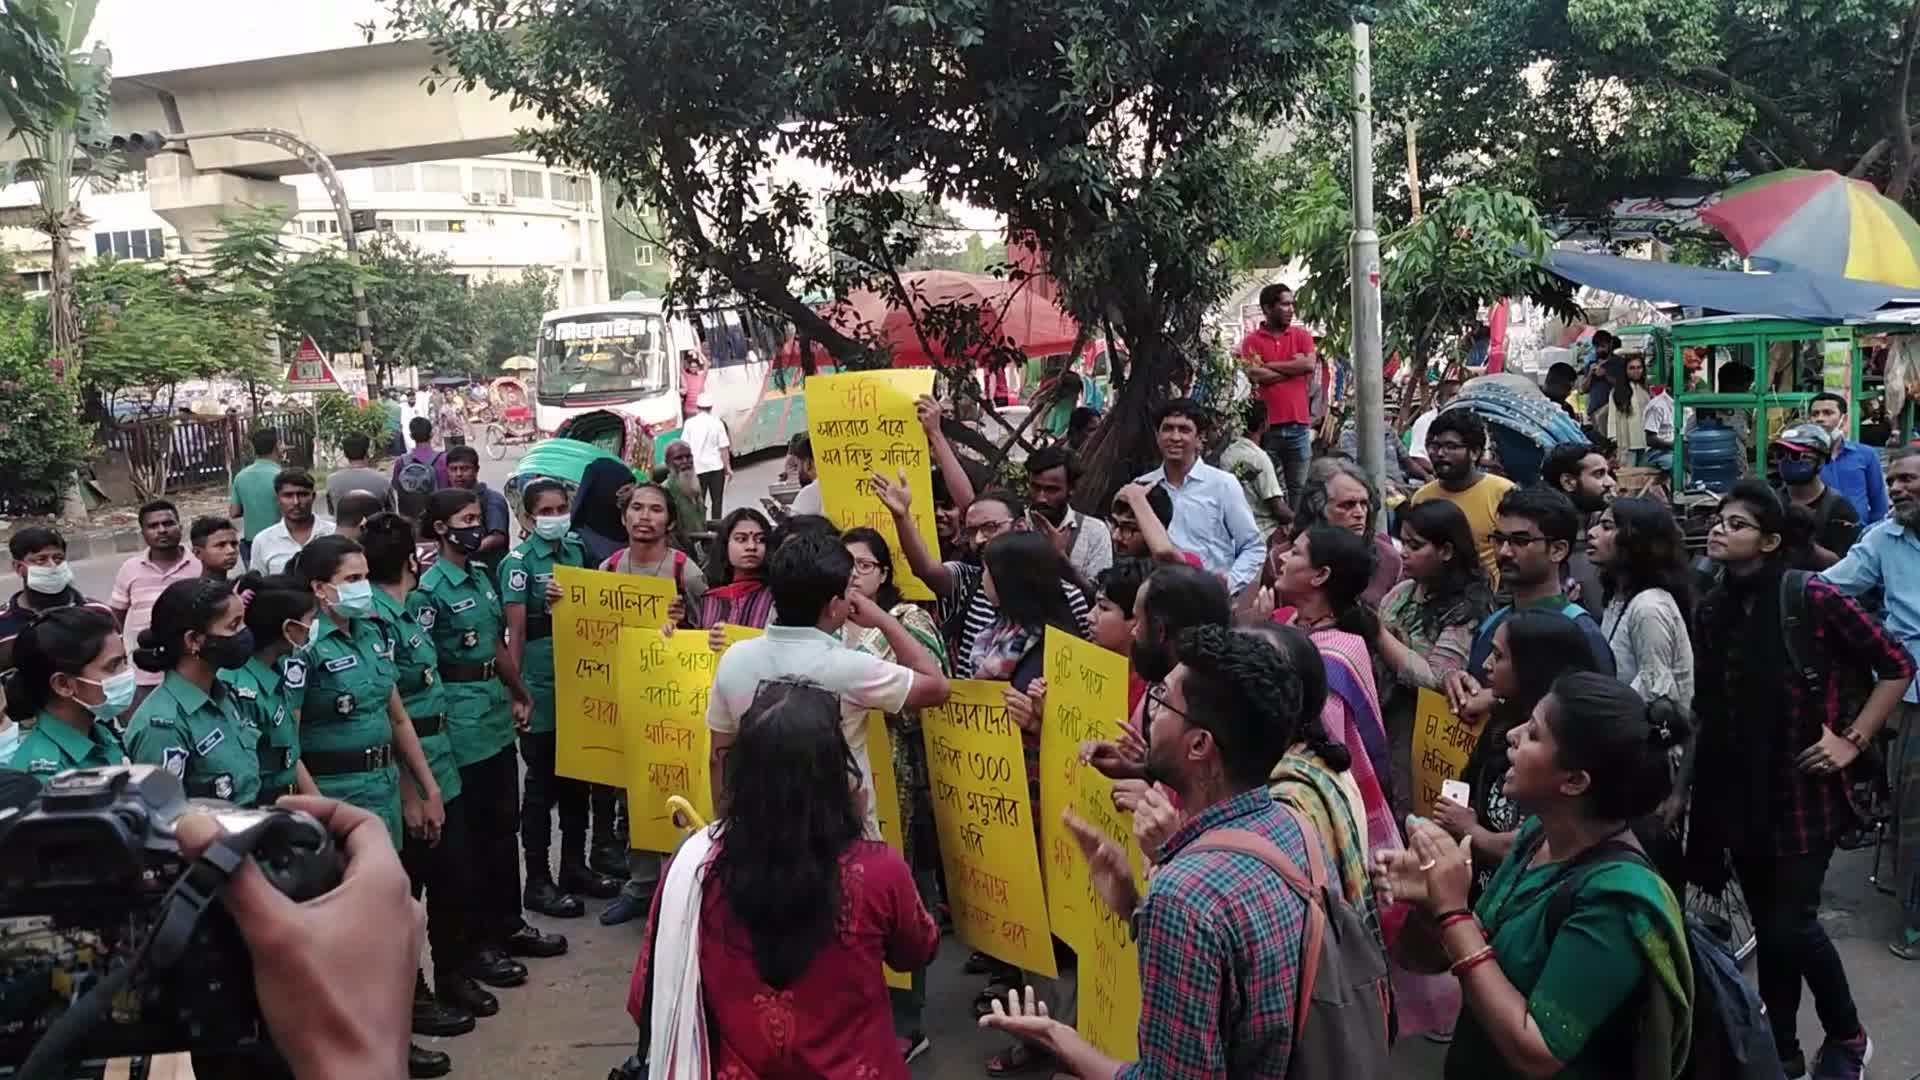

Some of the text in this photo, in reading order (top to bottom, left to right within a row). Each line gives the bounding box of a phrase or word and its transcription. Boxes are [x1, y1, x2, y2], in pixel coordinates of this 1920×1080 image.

[571, 582, 665, 619] চা মালিক
[1425, 713, 1440, 738] চা
[967, 751, 1012, 782] ৩০০
